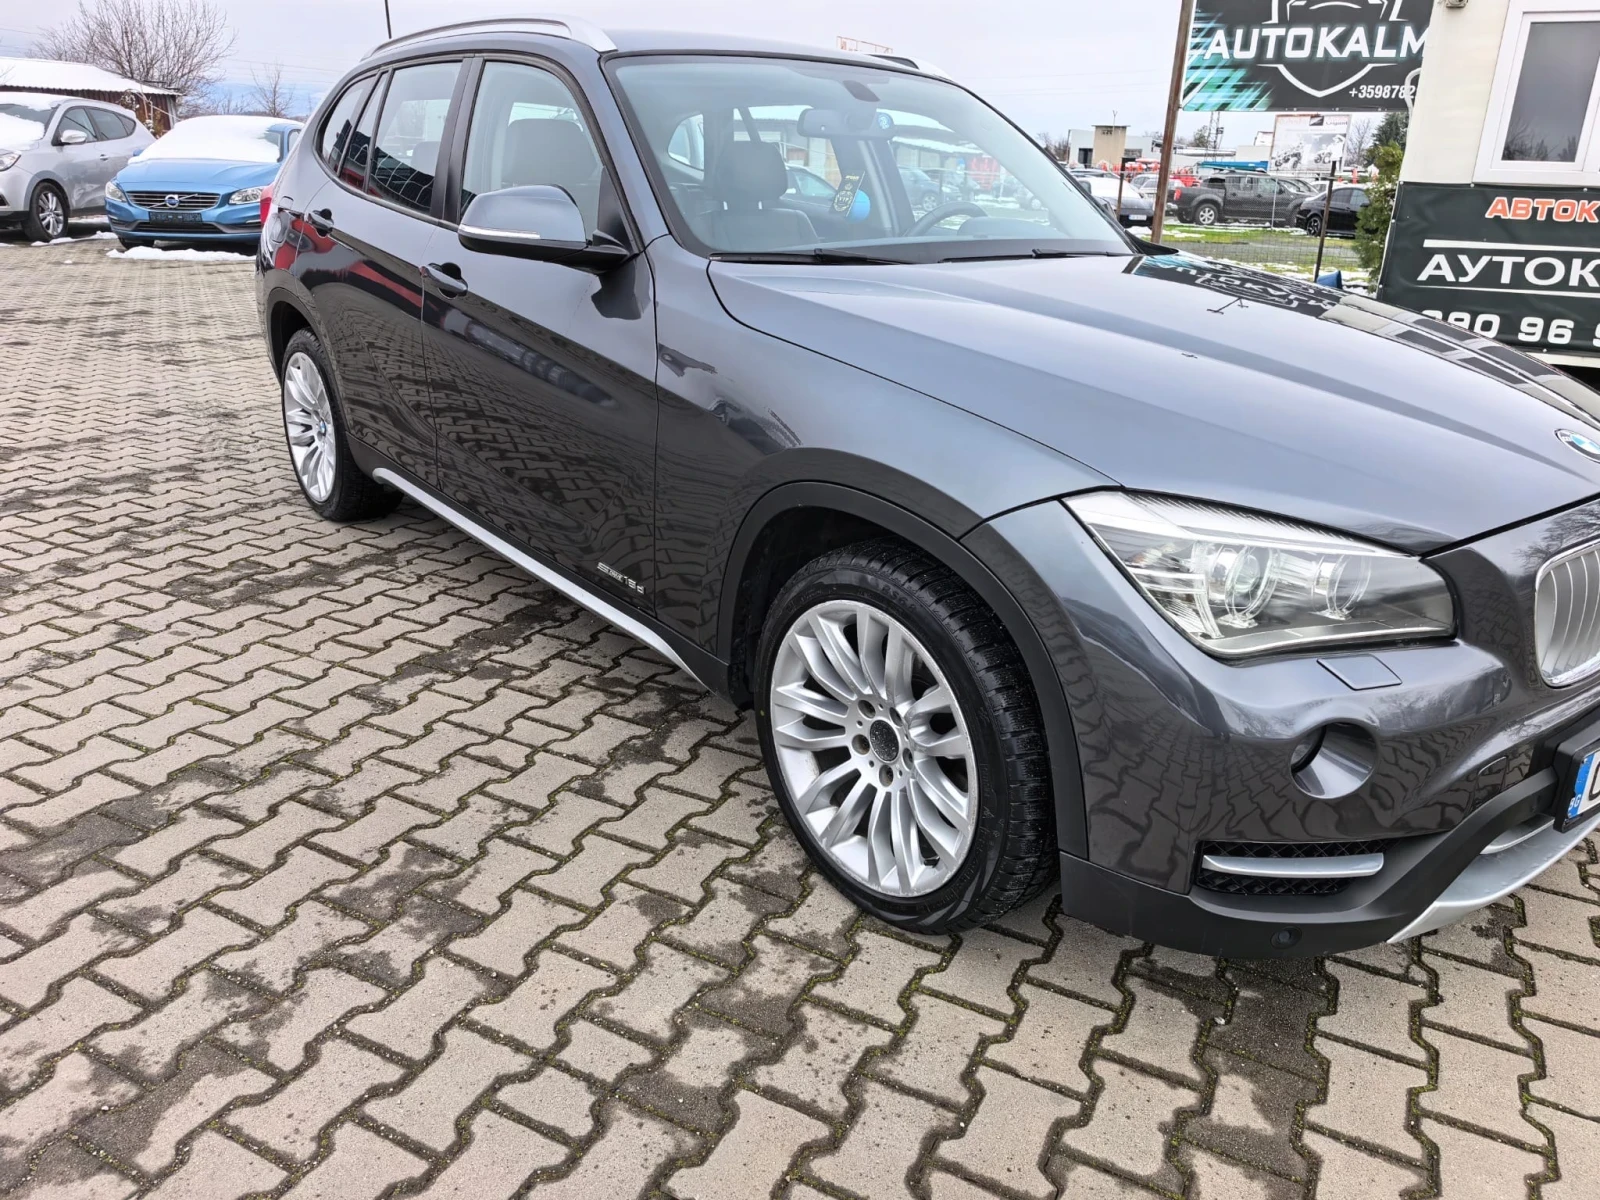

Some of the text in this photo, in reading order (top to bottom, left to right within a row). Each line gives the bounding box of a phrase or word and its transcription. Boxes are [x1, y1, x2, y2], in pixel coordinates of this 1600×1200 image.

[1485, 196, 1600, 223] АВТОК
[1416, 254, 1600, 287] АУТОК
[1517, 316, 1575, 344] 96
